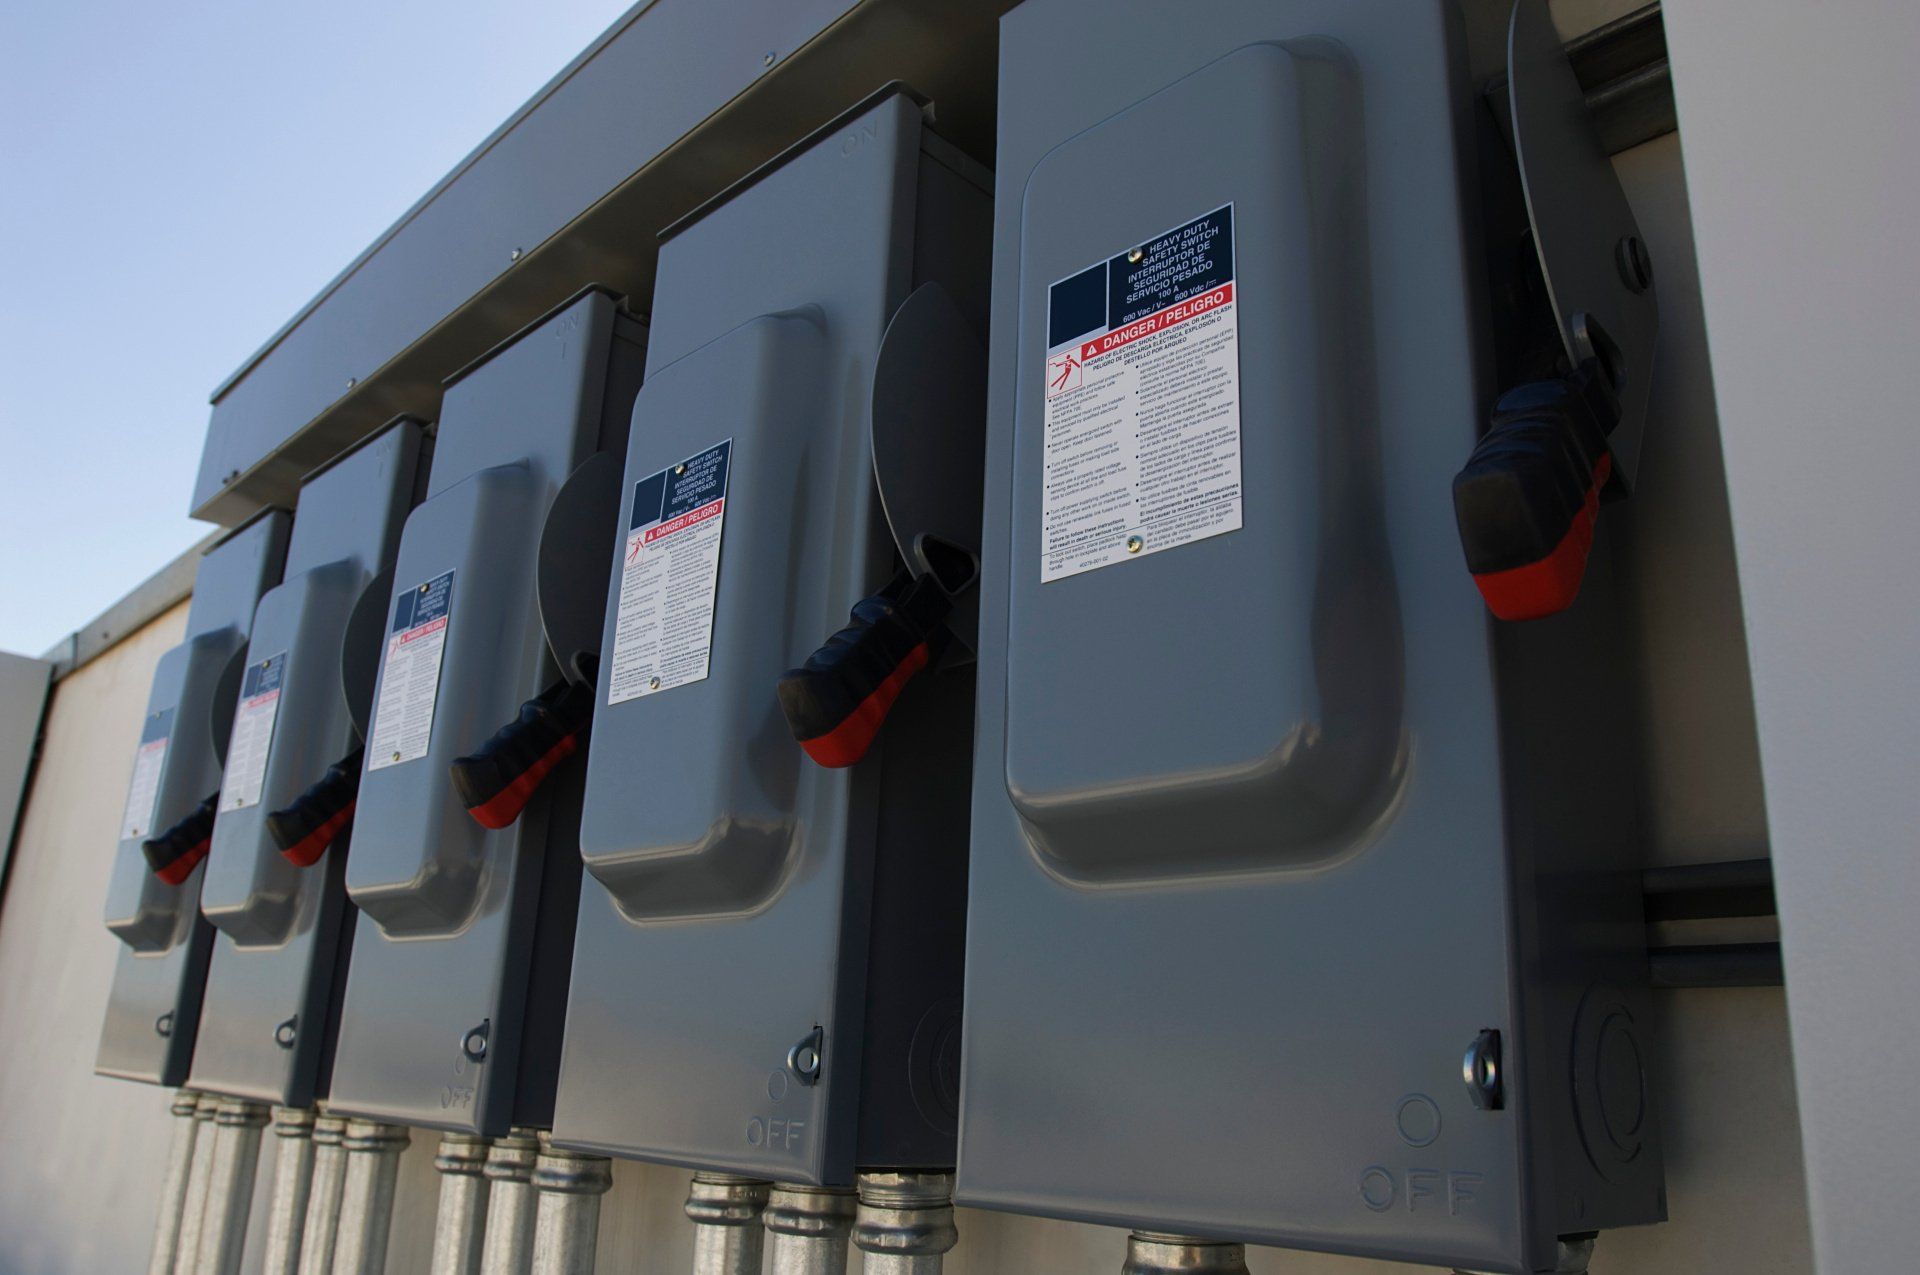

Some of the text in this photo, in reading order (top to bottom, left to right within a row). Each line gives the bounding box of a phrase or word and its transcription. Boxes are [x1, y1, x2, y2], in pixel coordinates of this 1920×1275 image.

[1142, 225, 1218, 267] SAFETY SWITCH
[1149, 219, 1209, 254] HEAVY DUTY
[1126, 259, 1212, 304] SERVICIO PESADO
[1128, 240, 1210, 283] INTERRUPTOR DE
[1133, 252, 1204, 291] SEGURIDAD DE
[1122, 312, 1135, 323] 600
[1137, 305, 1150, 317] Vac
[1174, 290, 1187, 302] 600
[1189, 283, 1204, 295] Vdc
[1158, 284, 1178, 299] 100 A
[1103, 290, 1223, 349] DANGER / PELIGRO
[656, 517, 683, 537] DANGER
[688, 503, 718, 524] PELIGRO
[746, 1116, 804, 1150] OFF
[1359, 1163, 1487, 1216] OFF
